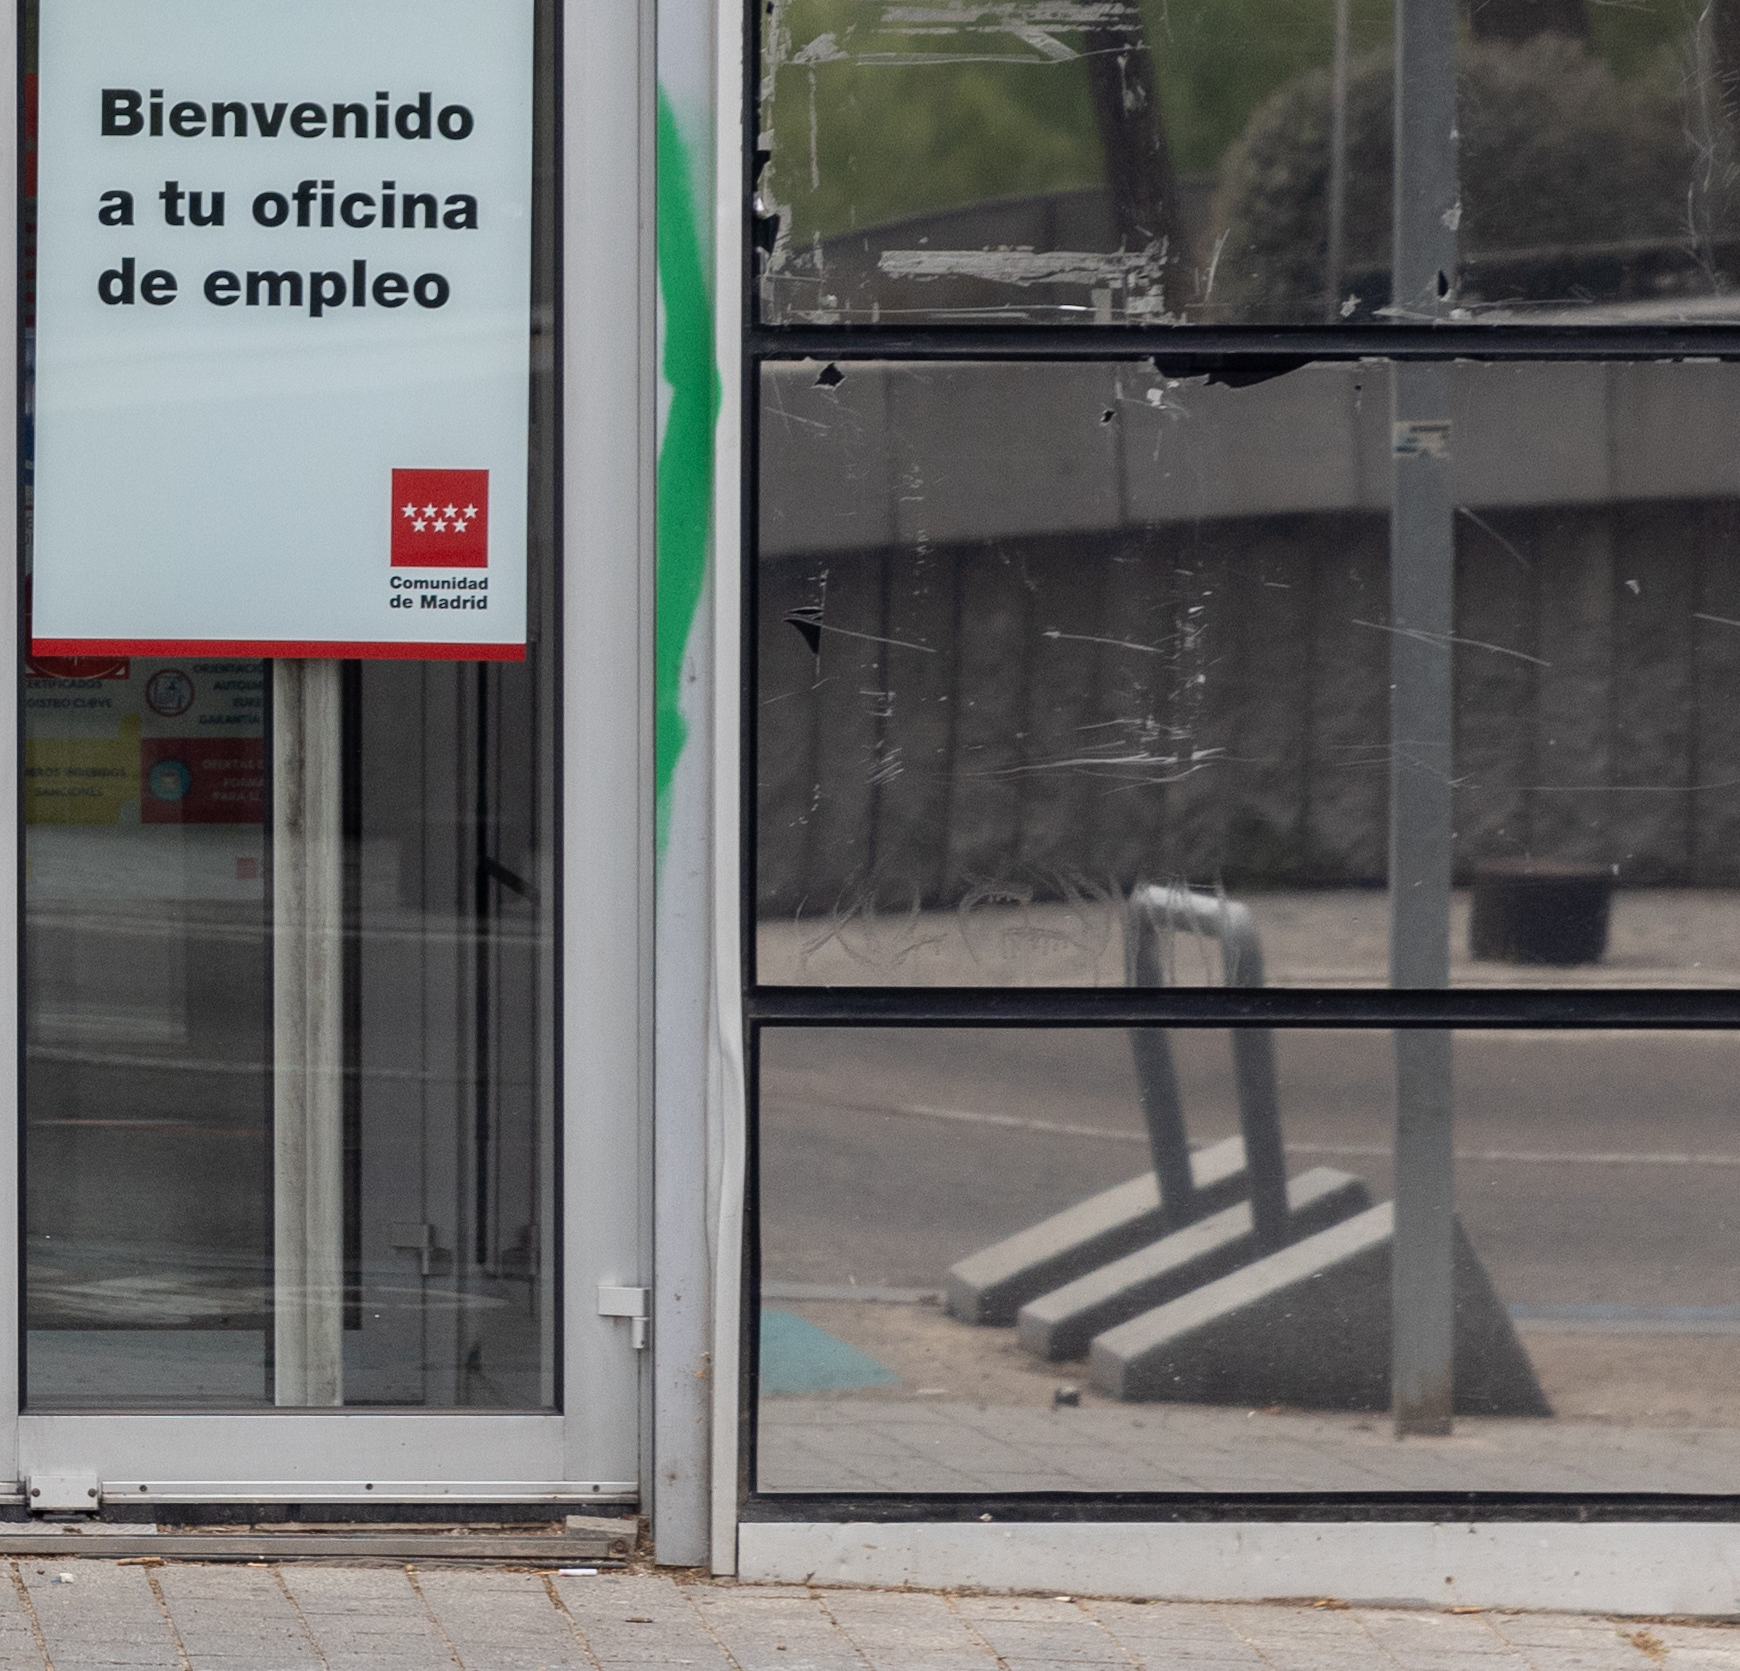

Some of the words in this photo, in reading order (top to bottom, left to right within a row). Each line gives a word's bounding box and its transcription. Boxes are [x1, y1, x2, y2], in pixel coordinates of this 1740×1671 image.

[100, 88, 474, 141] Bienvenido
[98, 190, 135, 227] a
[158, 180, 225, 227] tu
[251, 179, 479, 230] oficina
[97, 256, 178, 306] de
[203, 259, 450, 318] empleo
[389, 575, 489, 591] Comunidad
[389, 594, 414, 610] de
[420, 594, 488, 611] Madrid
